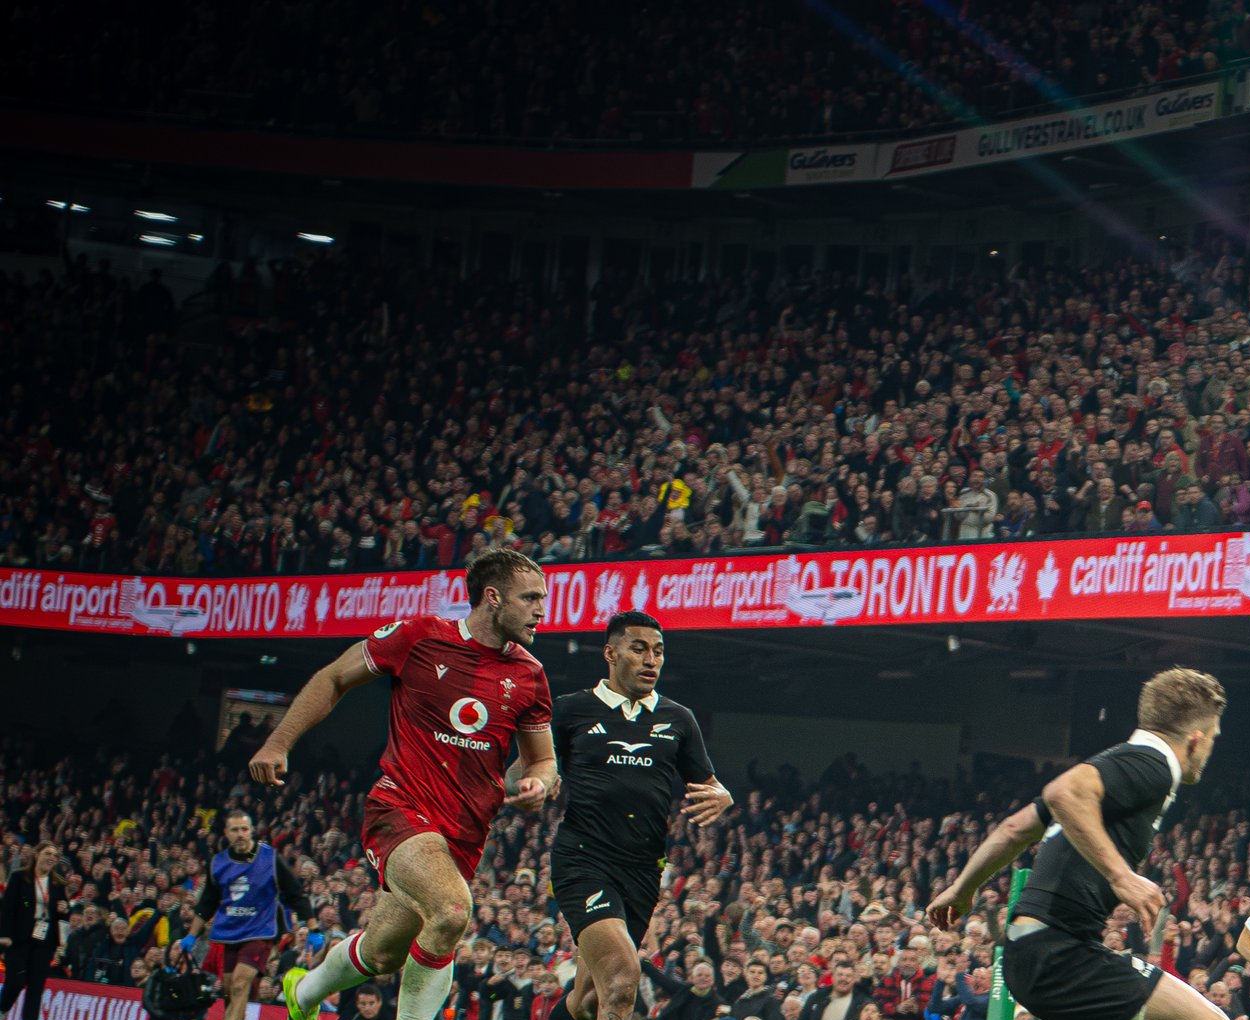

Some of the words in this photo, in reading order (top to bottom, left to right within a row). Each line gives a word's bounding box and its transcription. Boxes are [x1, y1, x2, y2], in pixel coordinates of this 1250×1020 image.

[335, 577, 382, 620] cardiff
[380, 576, 428, 621] airport
[657, 562, 715, 609] cardiff
[713, 562, 774, 622] airport
[830, 553, 977, 617] TORONTO
[1069, 542, 1146, 595] cardiff
[1143, 541, 1223, 609] airport
[40, 575, 118, 625] airport
[176, 583, 281, 632] TORONTO
[433, 731, 491, 751] vodafone
[606, 754, 653, 767] ALTRAD
